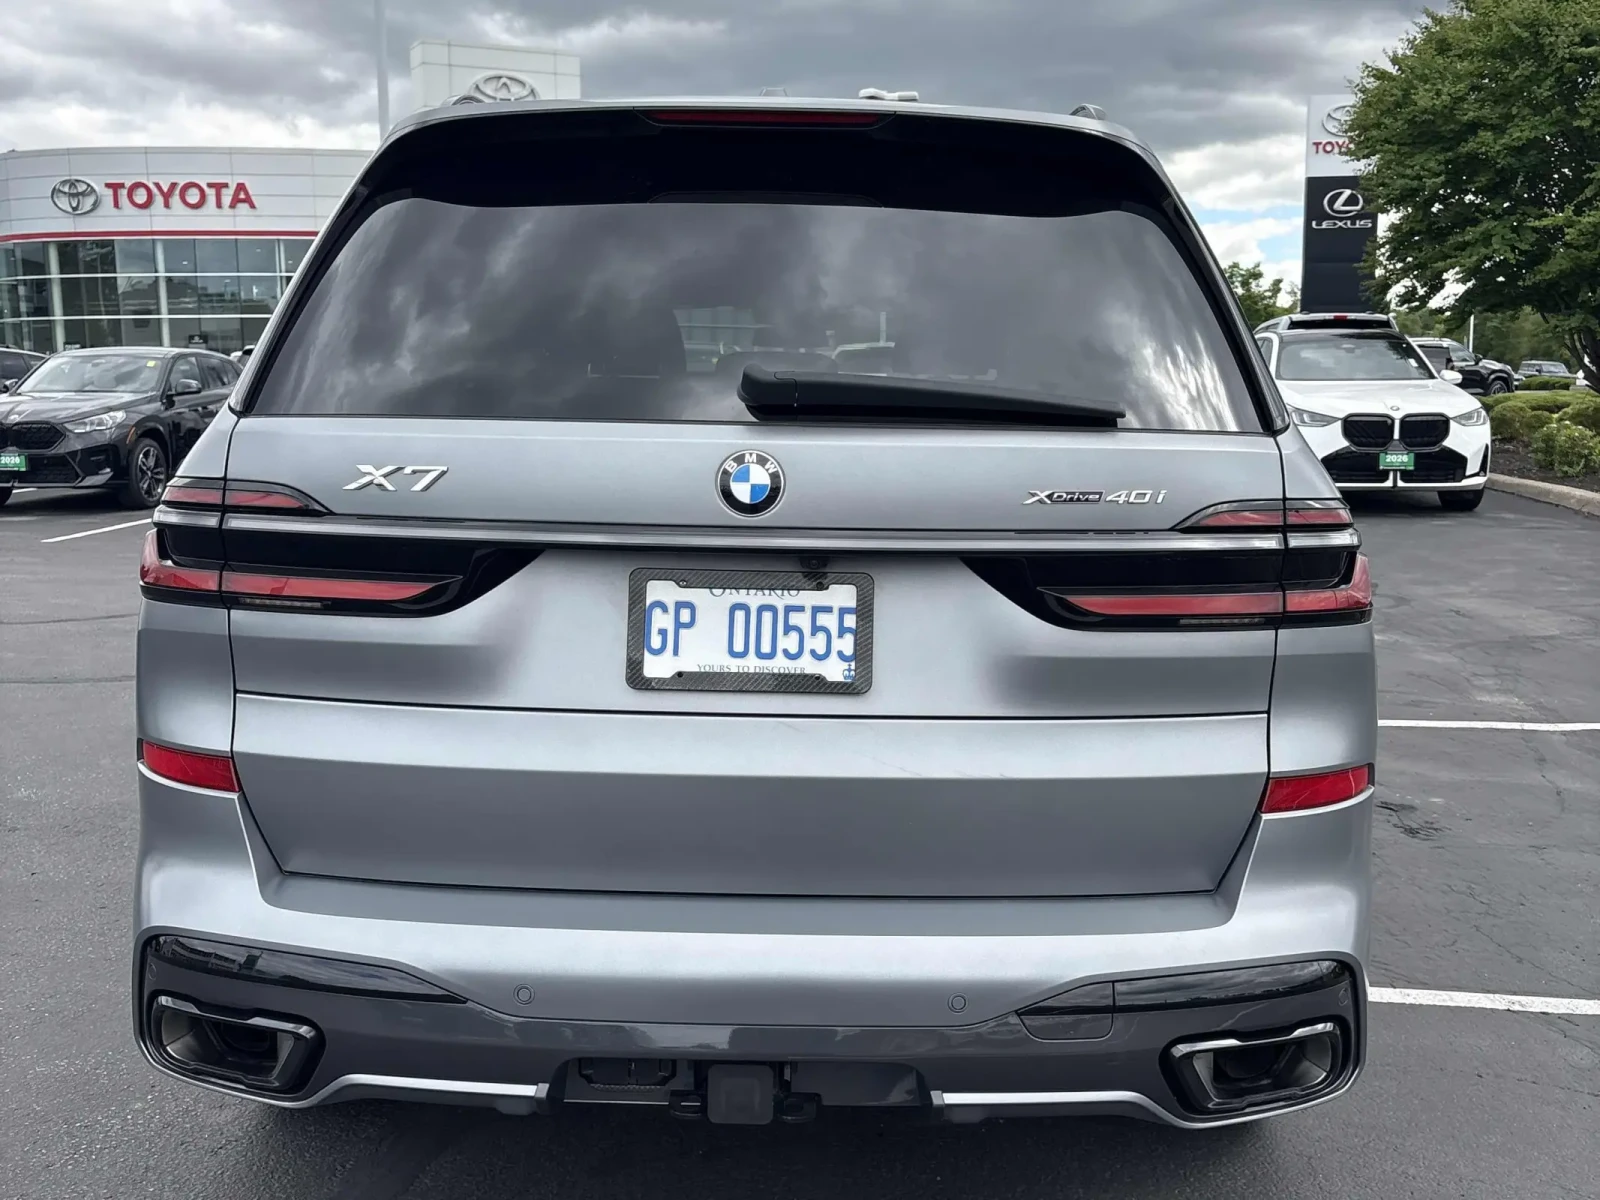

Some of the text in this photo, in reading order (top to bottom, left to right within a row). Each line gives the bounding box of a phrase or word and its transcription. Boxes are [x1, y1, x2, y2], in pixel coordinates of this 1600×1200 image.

[1312, 141, 1350, 154] TOY
[104, 181, 257, 210] TOYOTA
[1312, 219, 1372, 229] LEXUS
[724, 453, 778, 474] BMW
[1385, 454, 1409, 463] 2026
[342, 464, 448, 491] X7
[645, 600, 857, 663] GP 00555
[697, 663, 806, 674] YOURS TO DISCOVER
